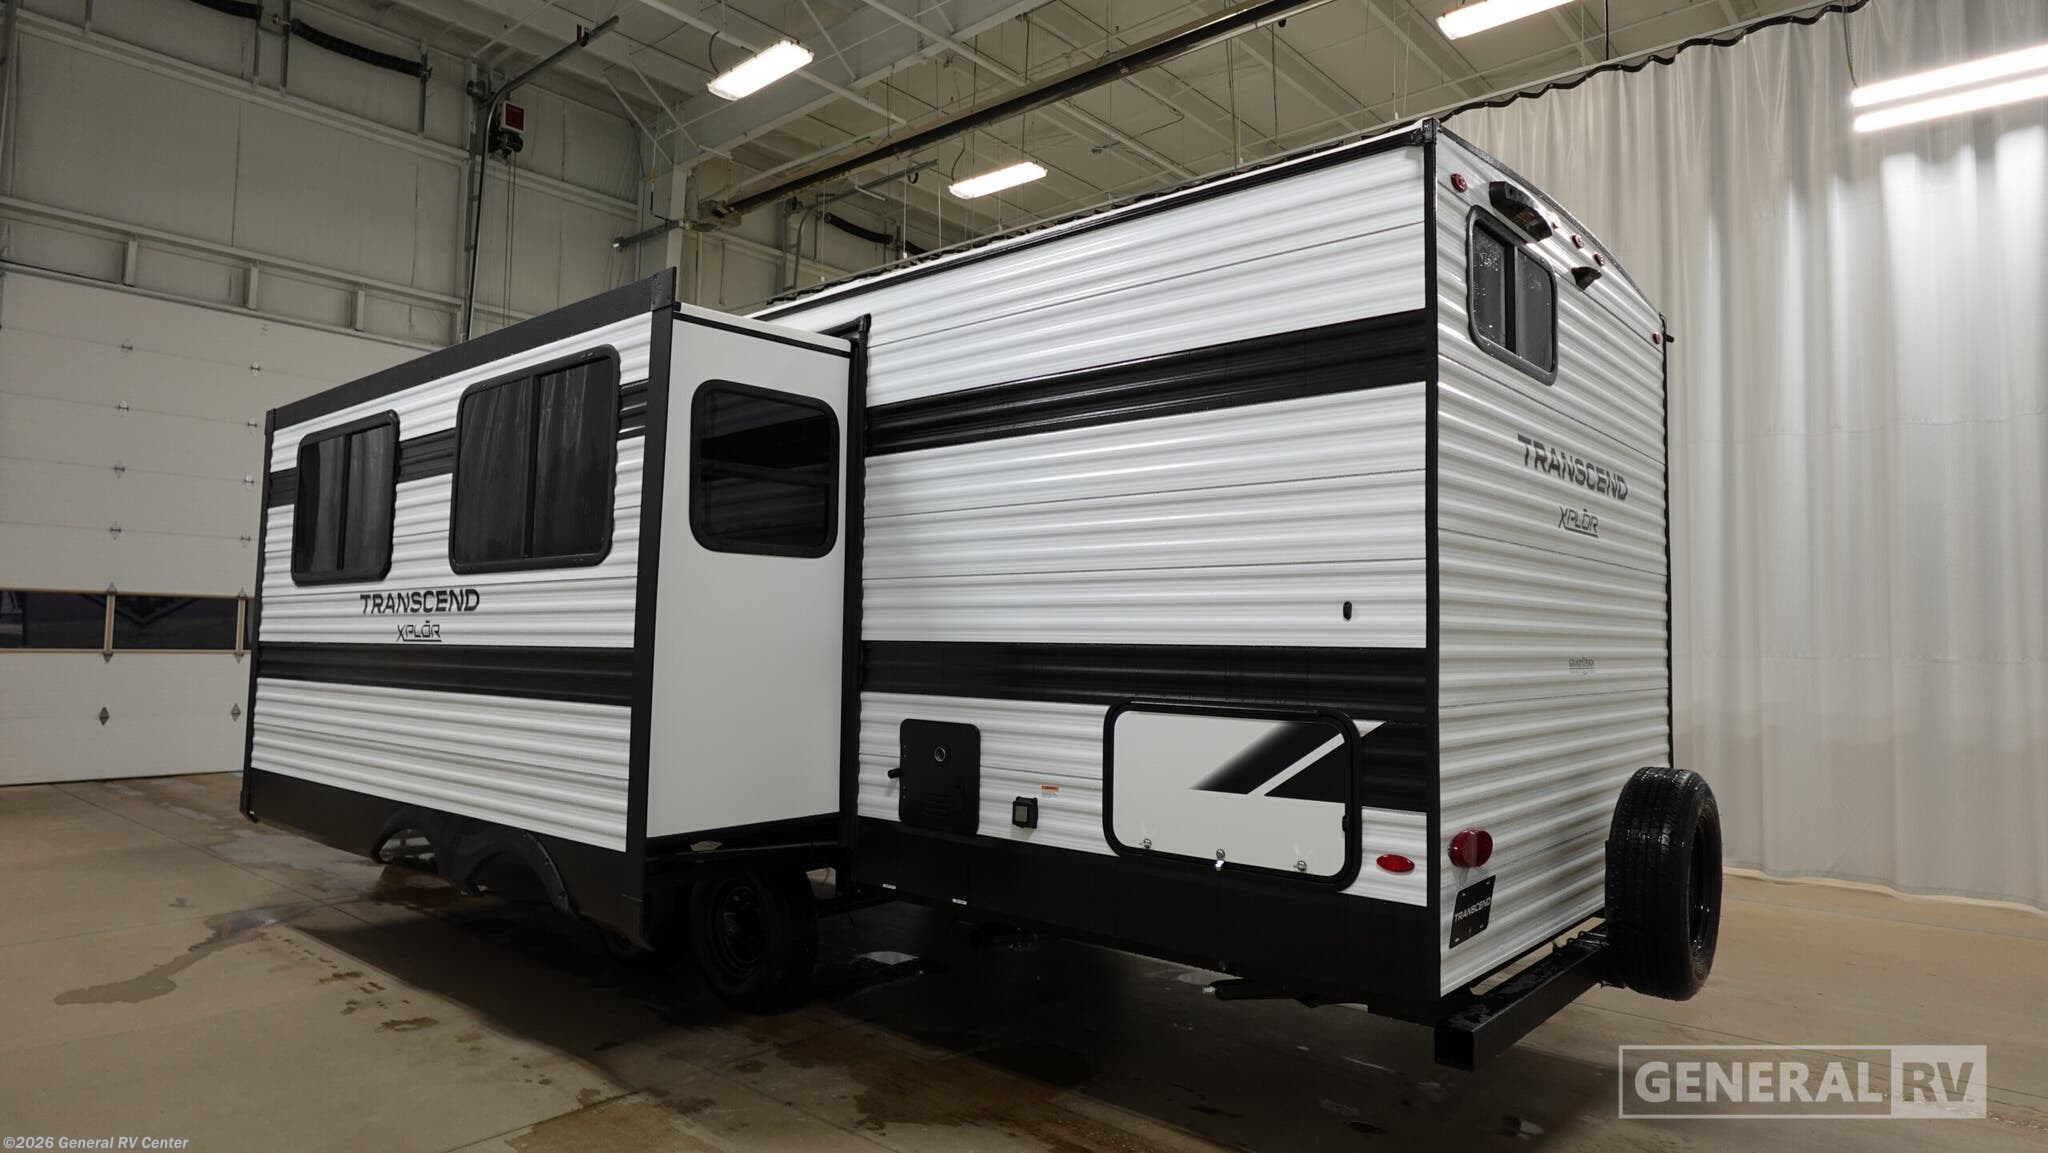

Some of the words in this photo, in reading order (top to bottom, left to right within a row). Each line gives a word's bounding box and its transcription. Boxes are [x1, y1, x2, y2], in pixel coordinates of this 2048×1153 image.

[1517, 433, 1628, 500] TRANSCEND
[360, 589, 479, 613] TRANSCEND
[1454, 897, 1491, 922] TRANSCEND
